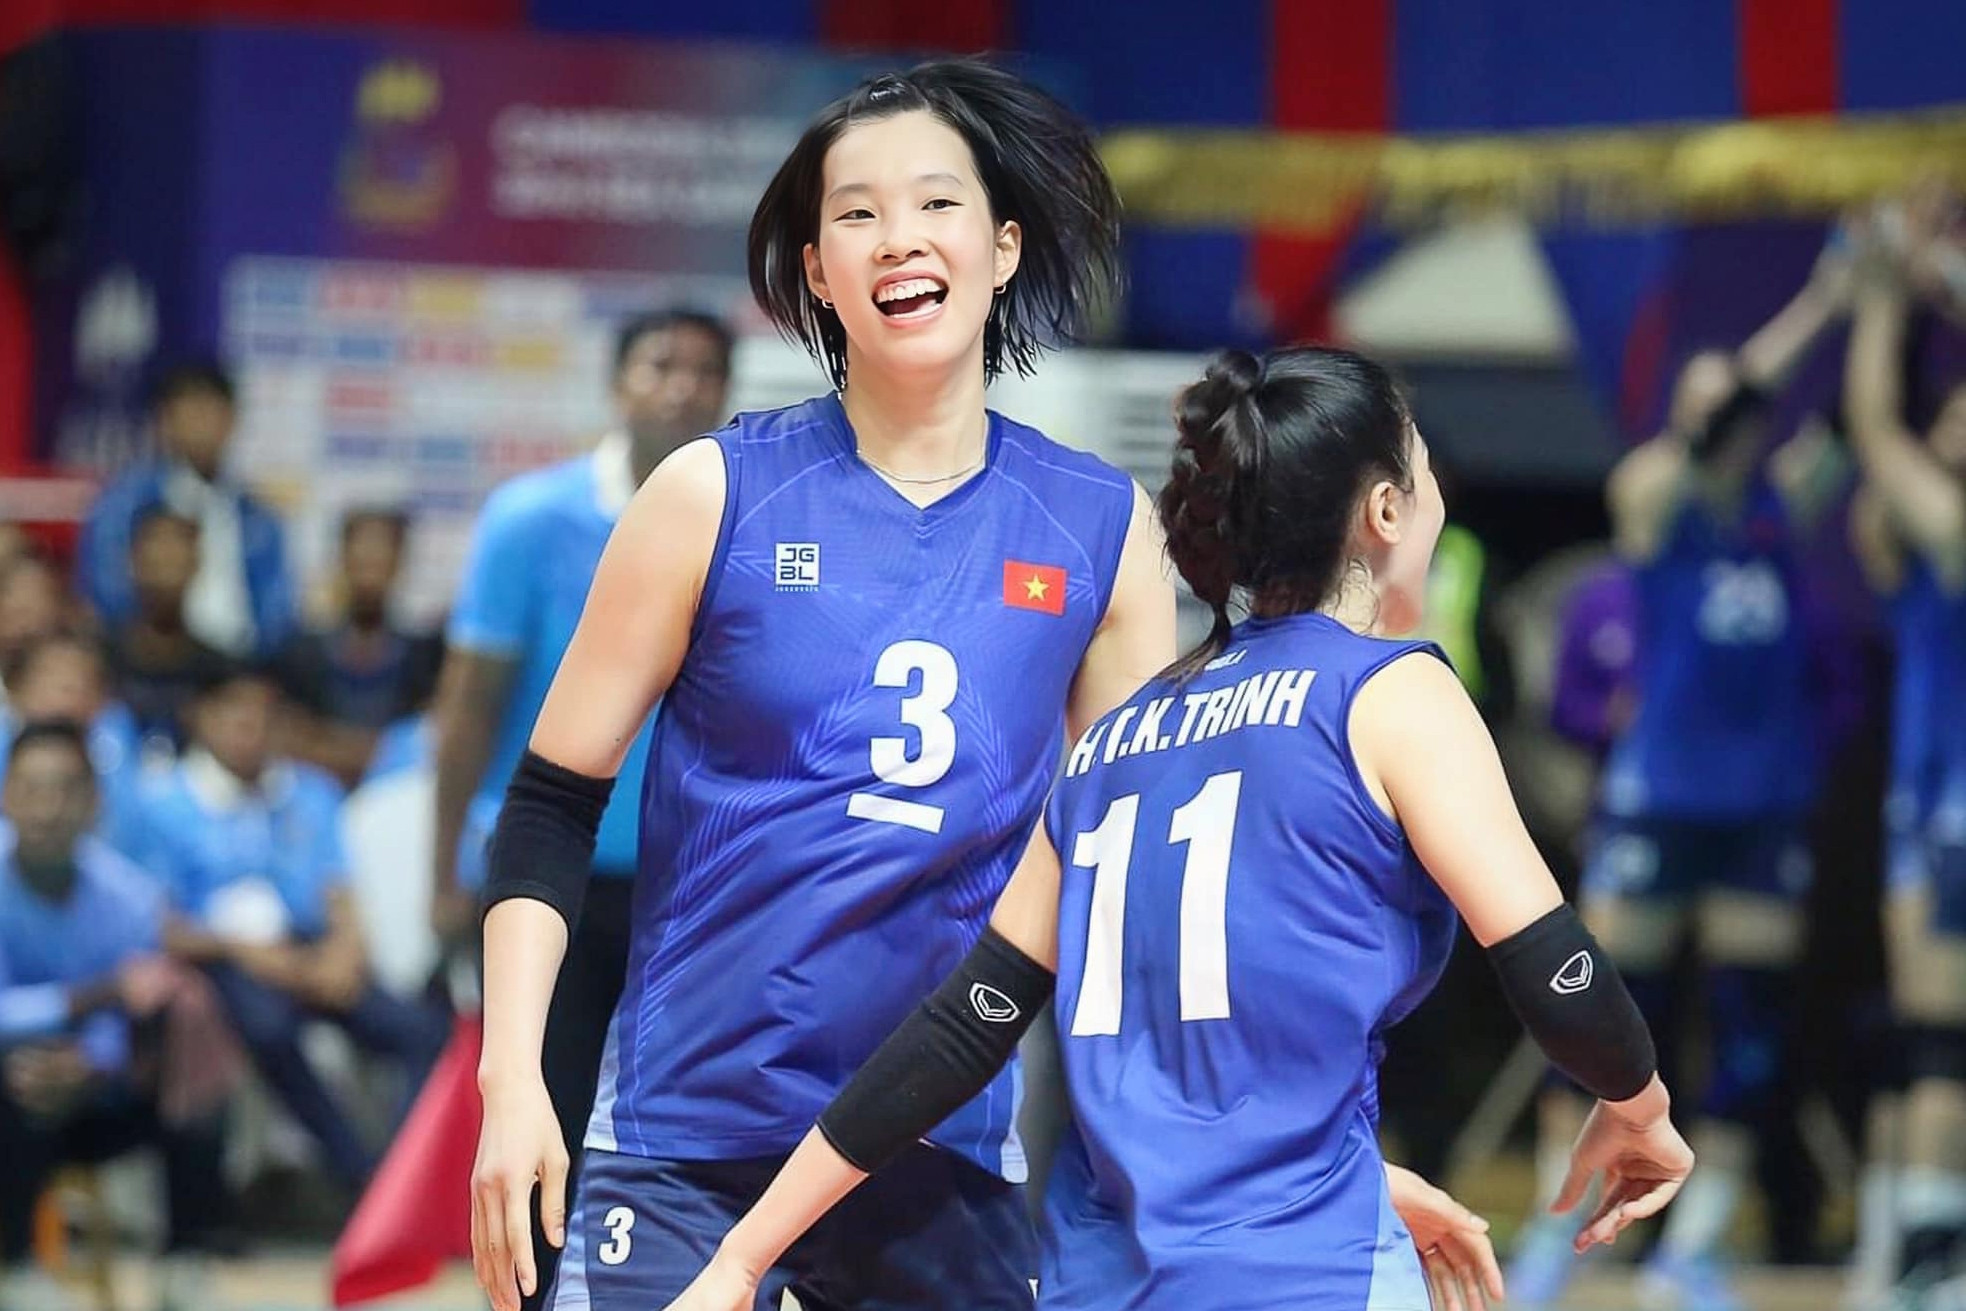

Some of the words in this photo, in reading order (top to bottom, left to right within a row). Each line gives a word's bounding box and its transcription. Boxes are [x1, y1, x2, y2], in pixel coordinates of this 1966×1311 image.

[780, 547, 815, 563] JG
[780, 566, 814, 580] BL
[869, 638, 960, 789] 3
[1070, 770, 1243, 1036] 11
[599, 1206, 636, 1266] 3
